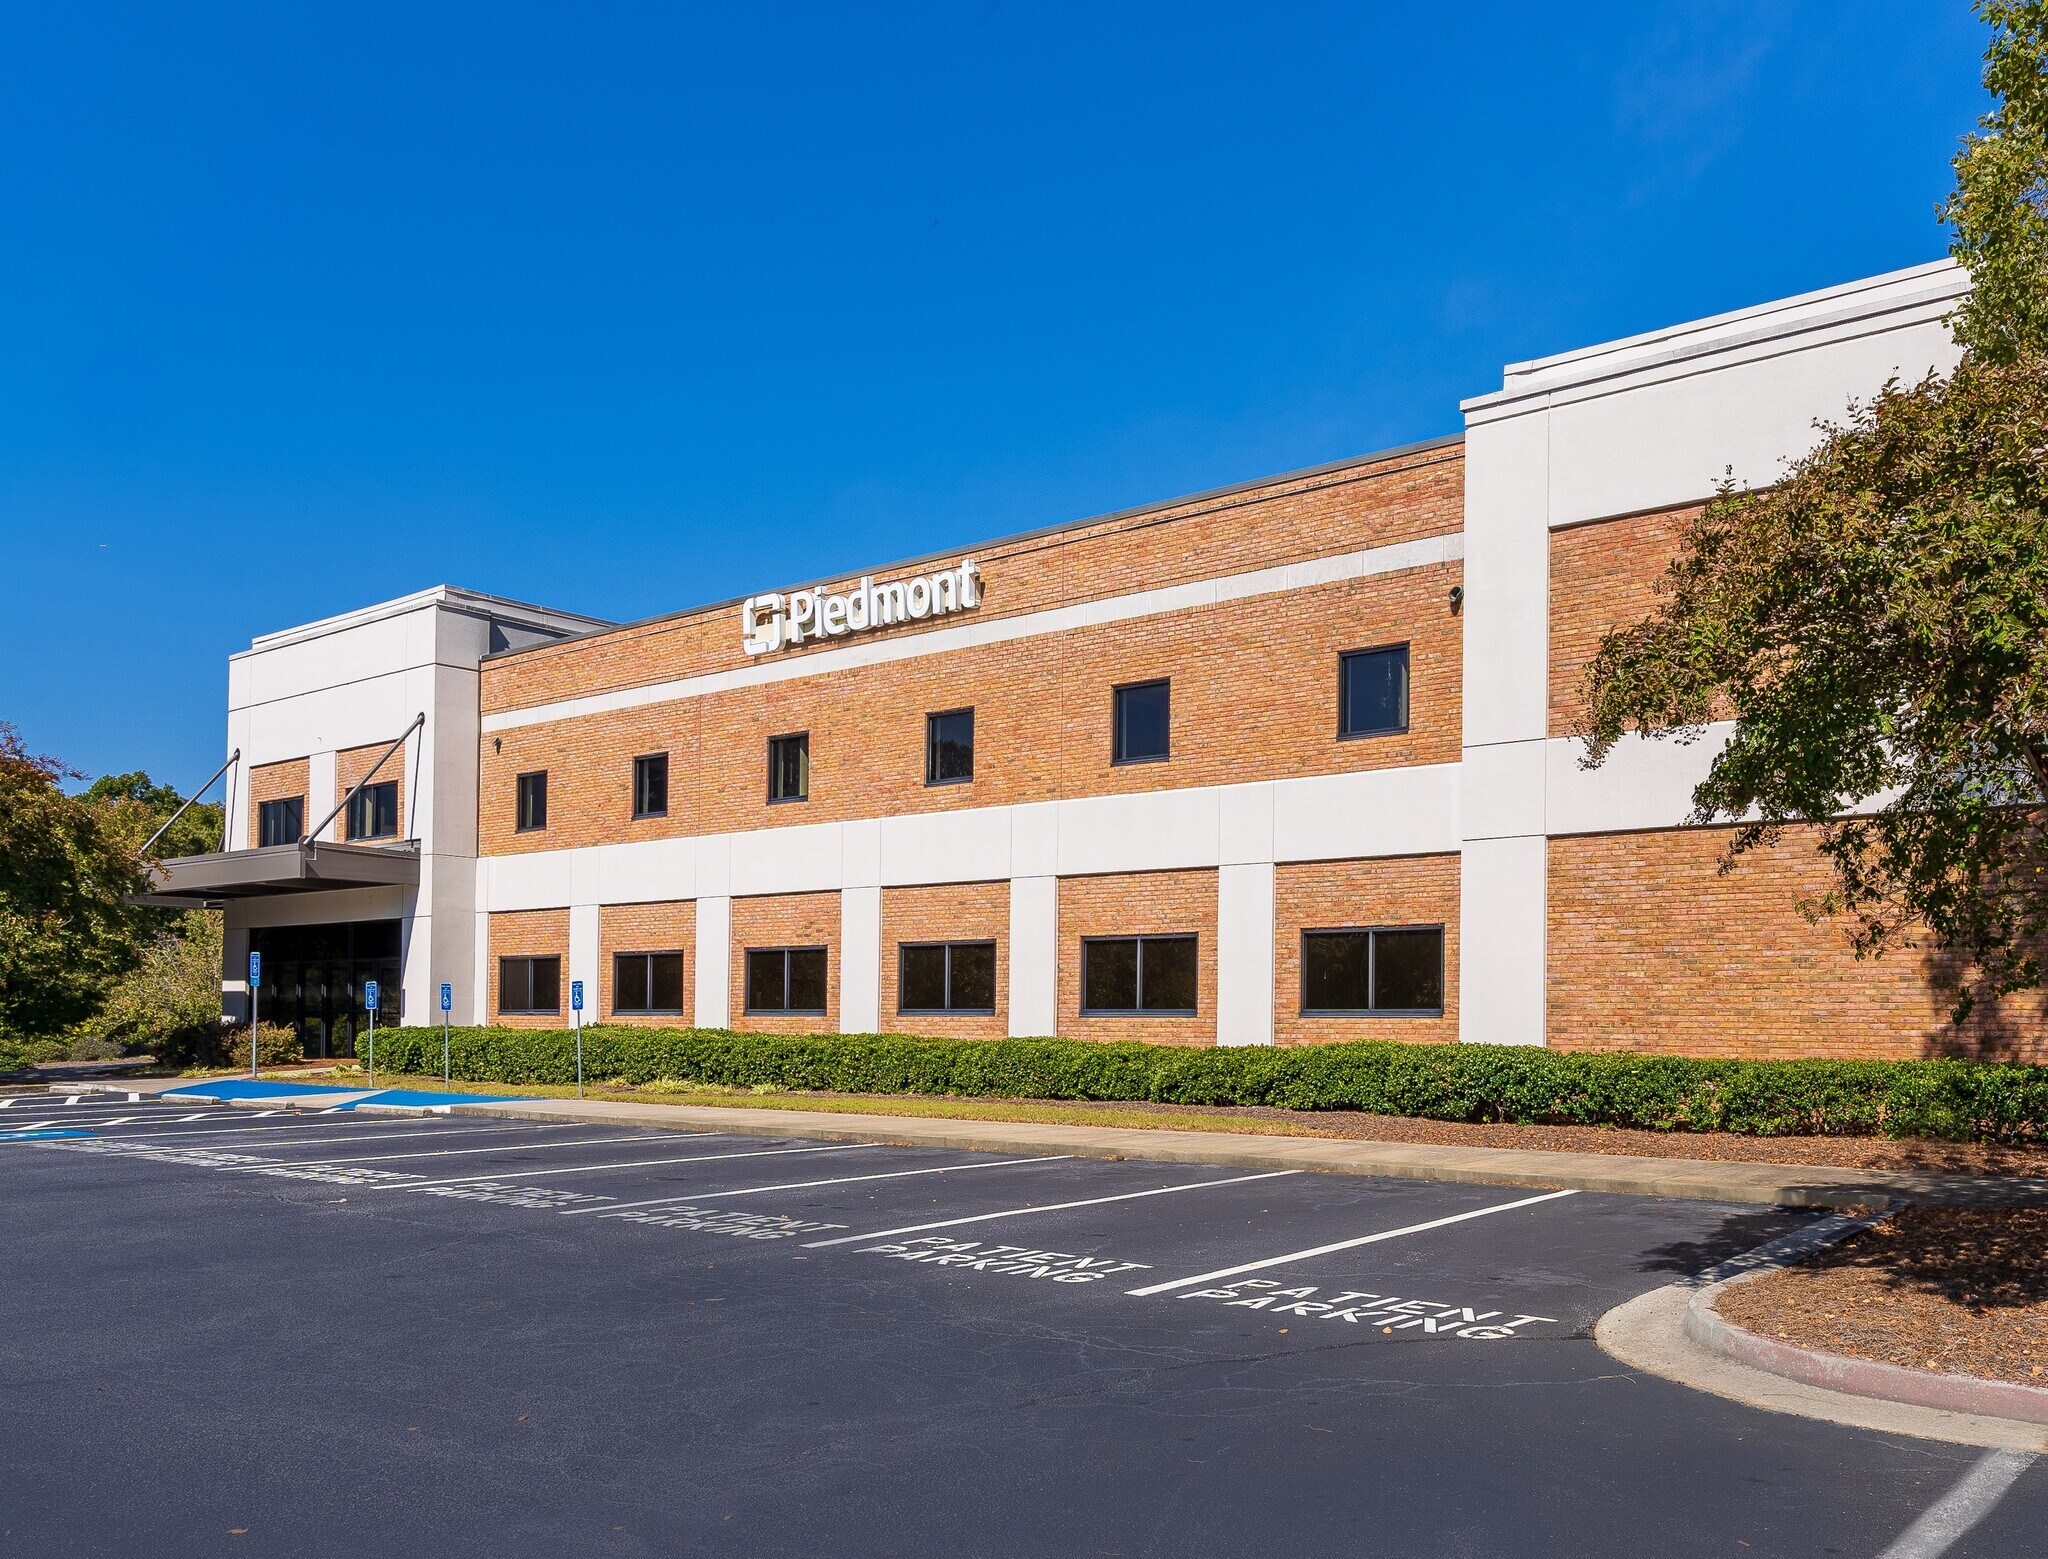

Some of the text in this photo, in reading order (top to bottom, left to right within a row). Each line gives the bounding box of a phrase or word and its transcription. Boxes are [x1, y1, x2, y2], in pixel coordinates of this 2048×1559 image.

[791, 558, 982, 643] Piedmont
[649, 1206, 850, 1232] PATIENT
[851, 1244, 1105, 1283] PARKING
[900, 1237, 1154, 1273] PATIENT
[1175, 1289, 1516, 1339] PARKING
[1222, 1279, 1559, 1327] PATIENT
